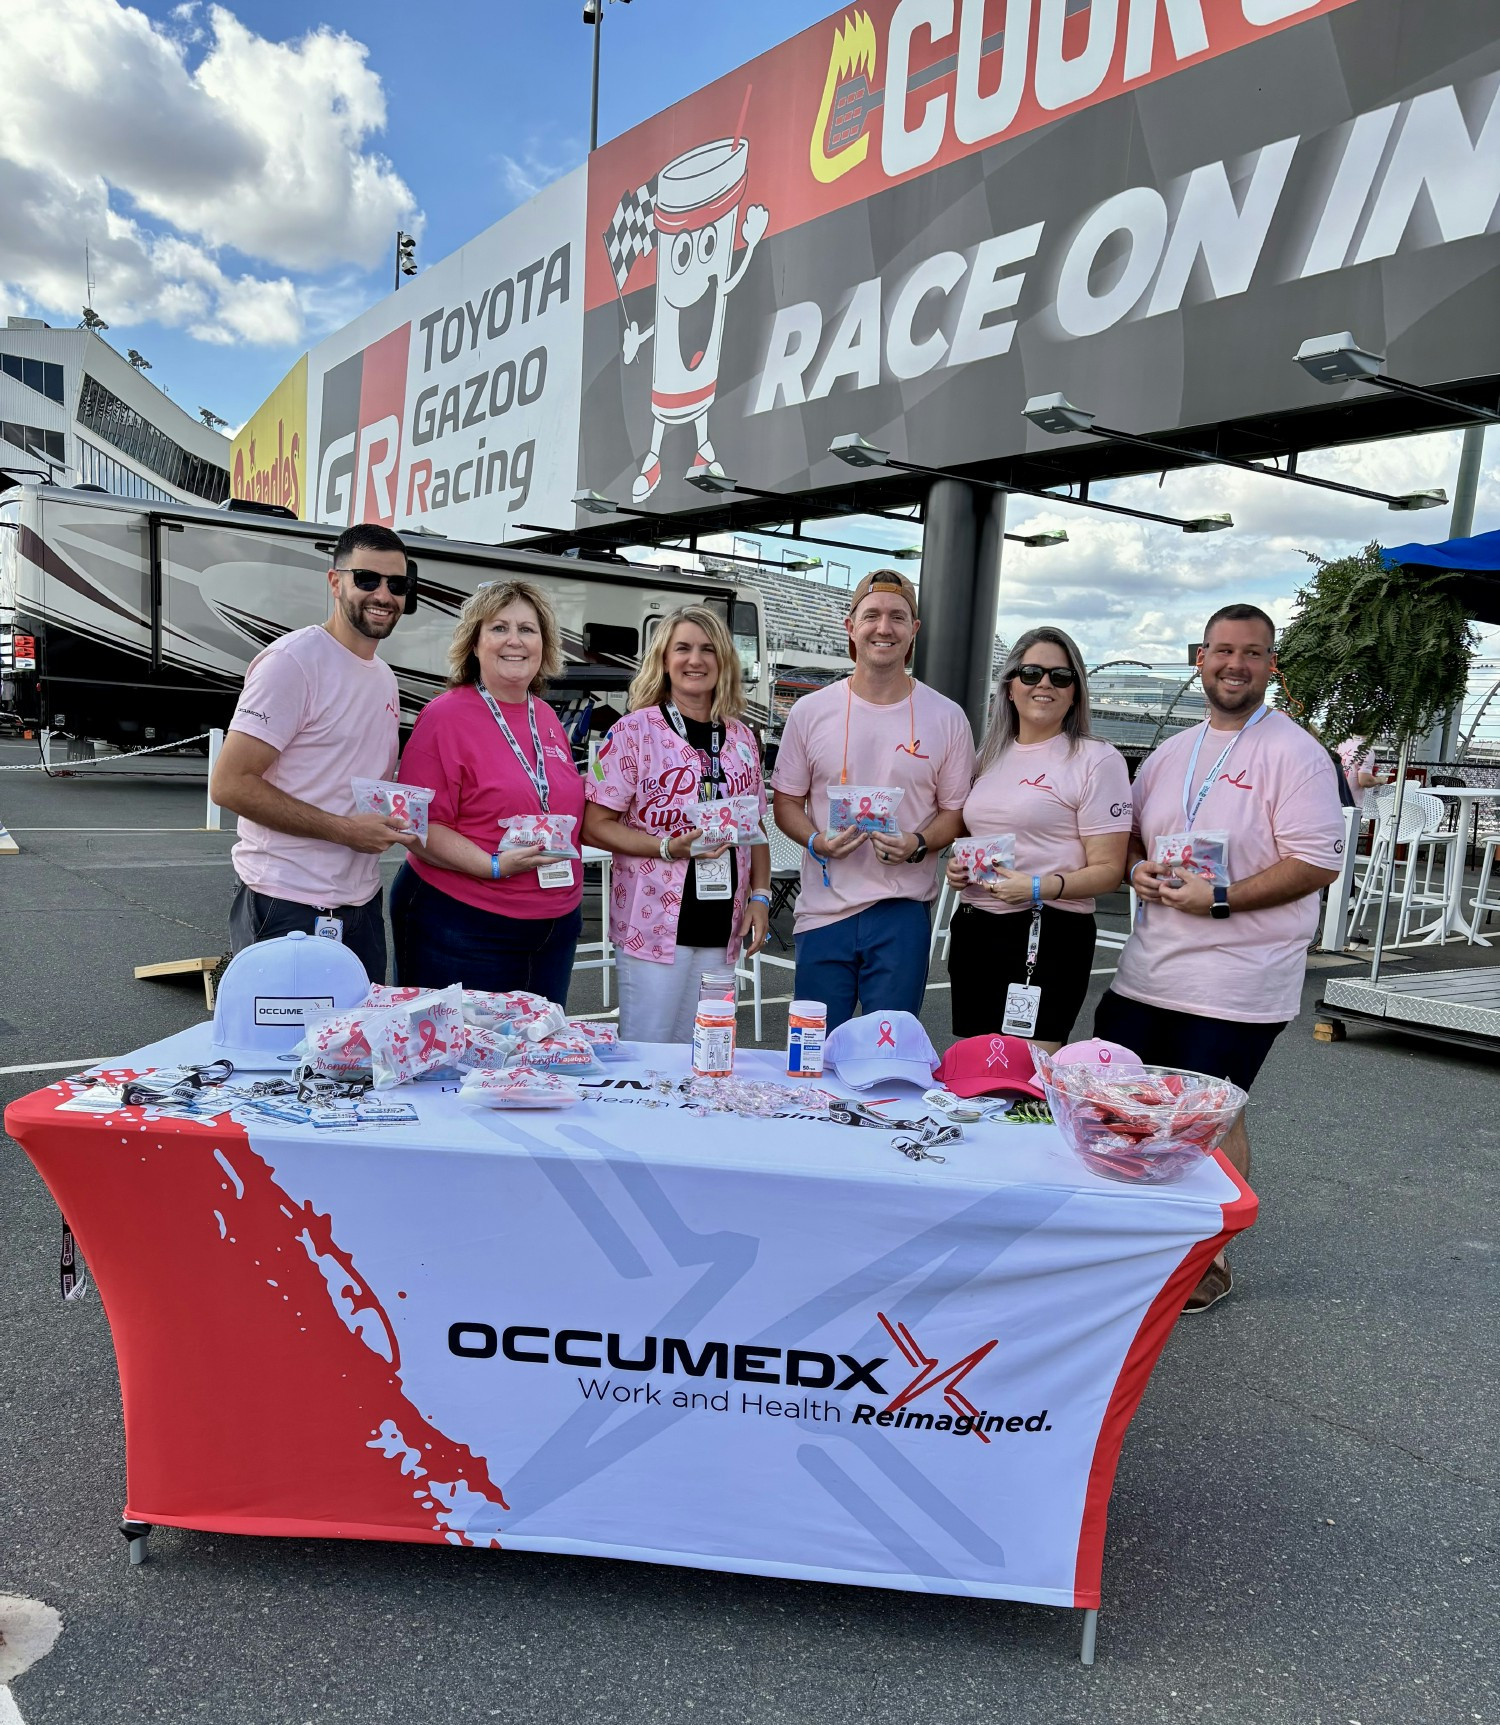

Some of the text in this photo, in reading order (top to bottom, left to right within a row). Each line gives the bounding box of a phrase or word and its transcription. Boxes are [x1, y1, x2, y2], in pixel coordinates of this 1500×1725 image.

[754, 71, 1500, 414] RACE ON IN
[419, 242, 571, 373] TOYOTA
[412, 345, 548, 447] GAZOO
[318, 414, 399, 526] GR
[405, 436, 536, 518] Racing
[428, 1001, 460, 1021] Hope
[311, 1056, 361, 1077] Strength
[516, 1051, 562, 1069] Strength
[448, 1321, 889, 1395] OCCUMEDX
[578, 1377, 1053, 1435] Work and Health Reimagined.
